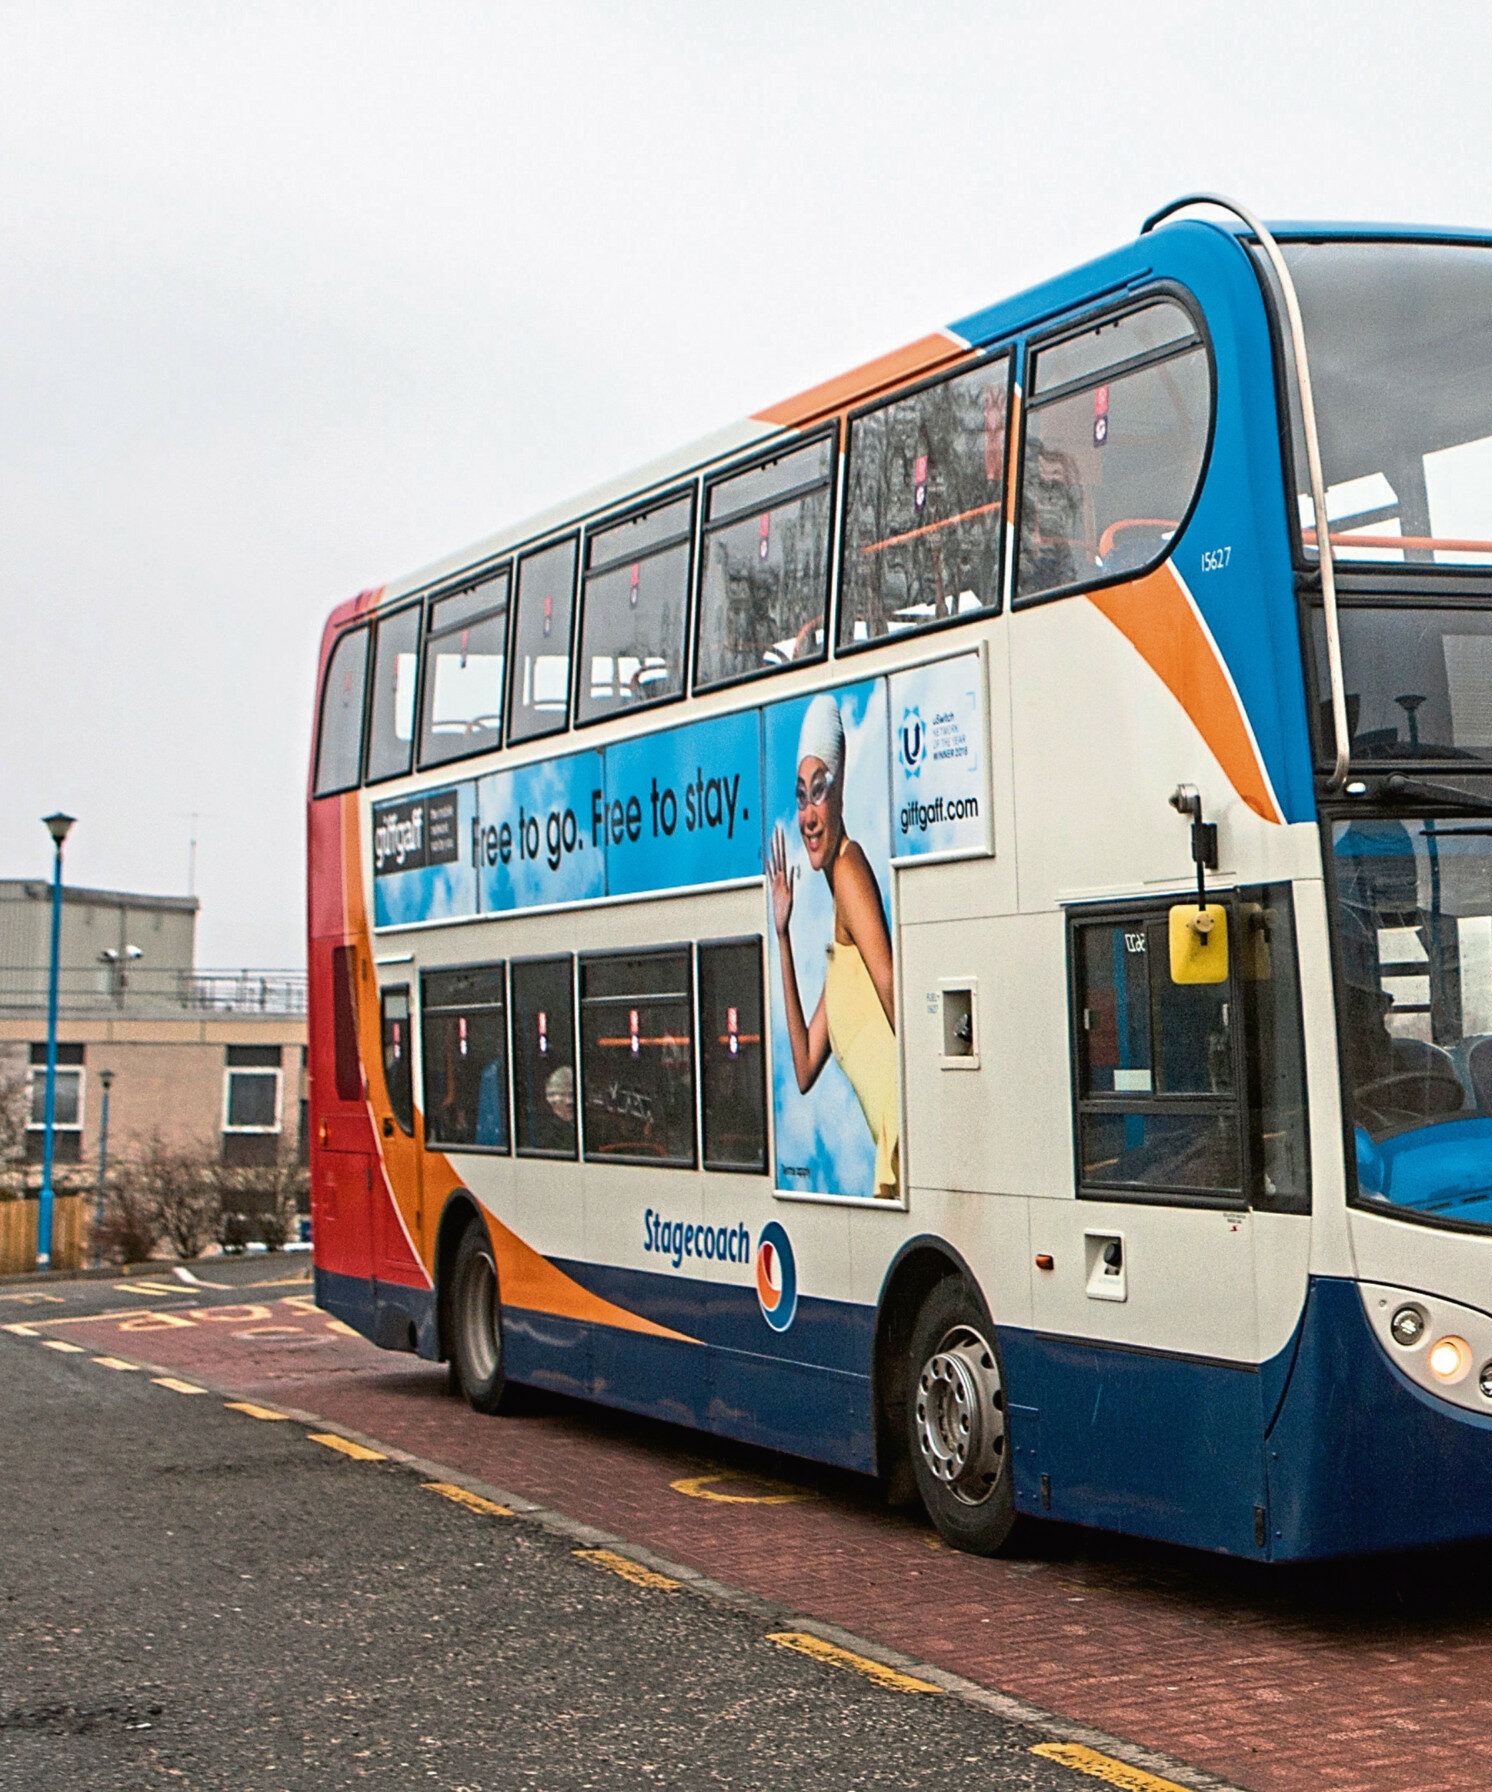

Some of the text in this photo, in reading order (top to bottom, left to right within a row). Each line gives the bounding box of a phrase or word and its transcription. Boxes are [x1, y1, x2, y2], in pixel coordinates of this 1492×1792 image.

[1202, 546, 1232, 572] 15627
[472, 816, 512, 868] Free
[519, 805, 539, 860] to
[547, 808, 583, 871] go.
[592, 788, 642, 847] Free
[651, 777, 677, 837] to
[686, 767, 749, 839] stay.
[901, 797, 979, 834] giffgaff.com
[644, 1208, 750, 1269] Stagecoach
